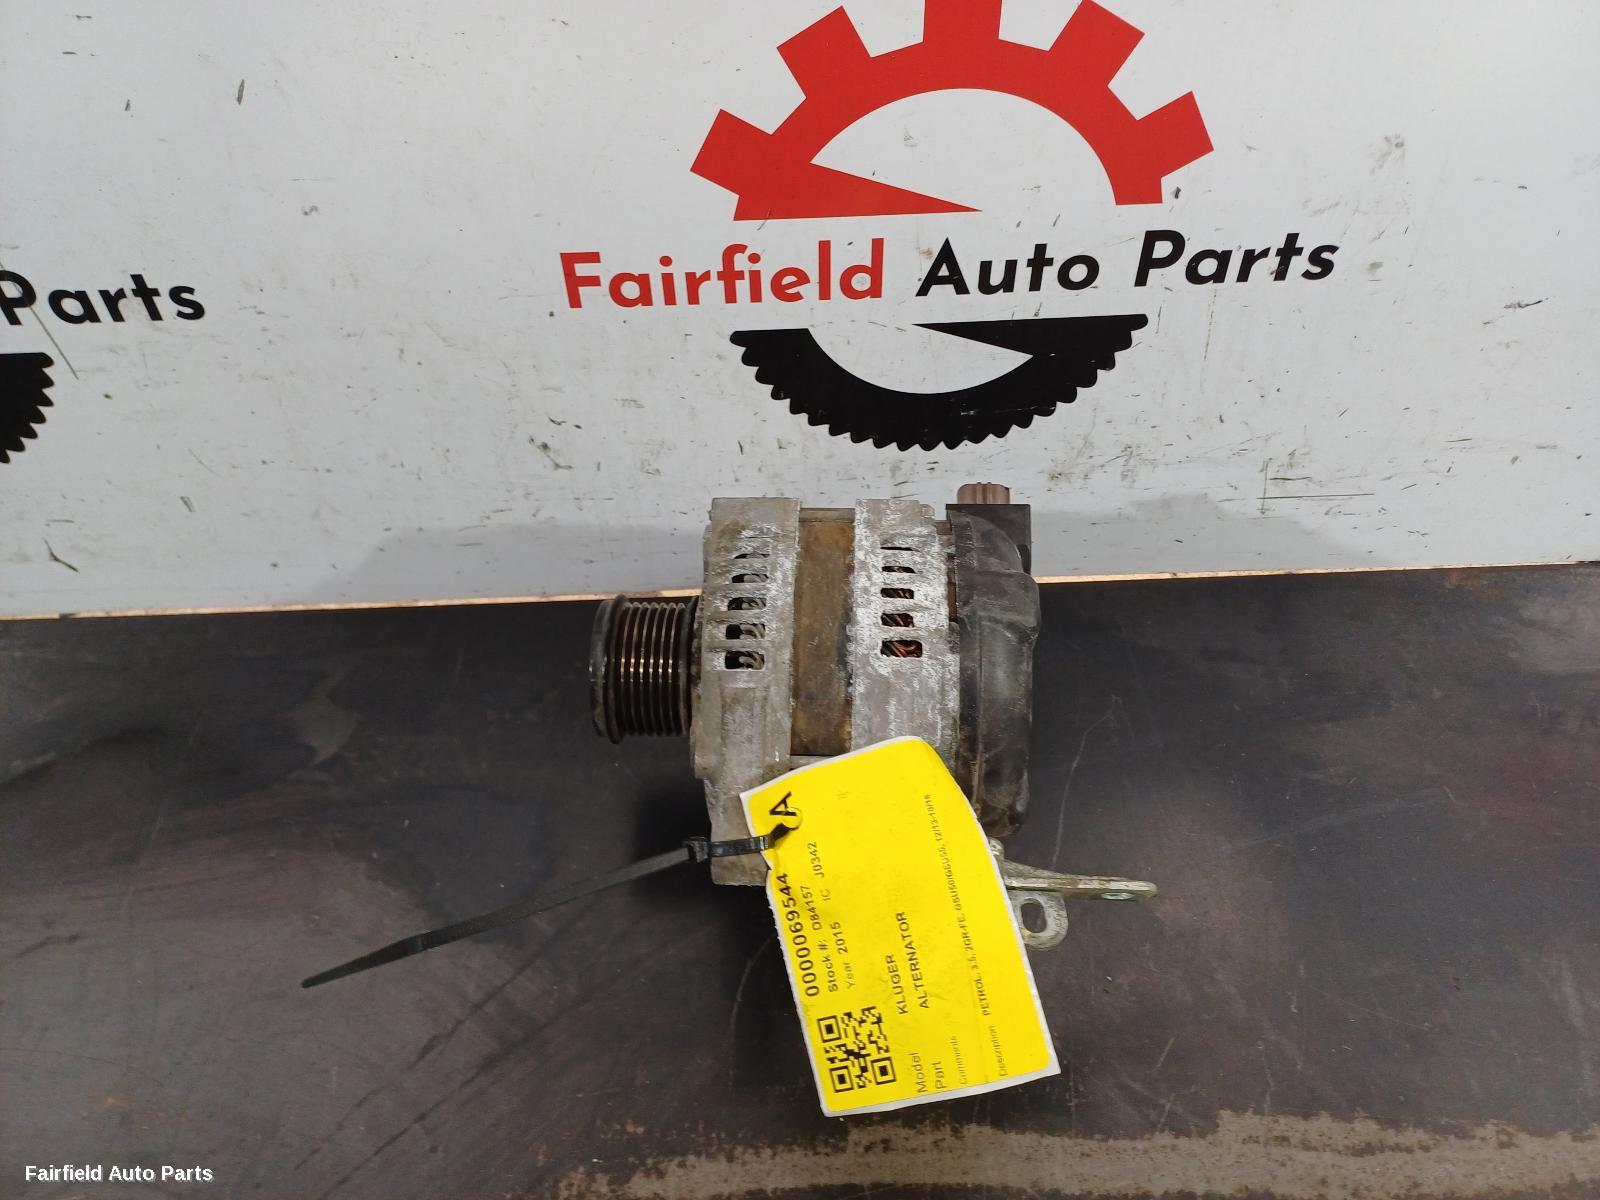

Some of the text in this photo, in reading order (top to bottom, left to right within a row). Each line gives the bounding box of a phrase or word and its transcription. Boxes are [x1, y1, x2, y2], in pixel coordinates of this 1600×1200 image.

[560, 230, 1339, 308] Fairfield Auto Parts
[0, 269, 205, 325] Parts
[769, 791, 798, 817] A
[800, 885, 822, 931] D84157
[776, 872, 820, 997] 0000069544
[830, 921, 849, 955] 2015
[821, 954, 839, 993] Stock
[843, 962, 857, 990] Year
[885, 953, 929, 1093] Model KLUGER
[895, 911, 948, 1090] Part ALTERNATOR
